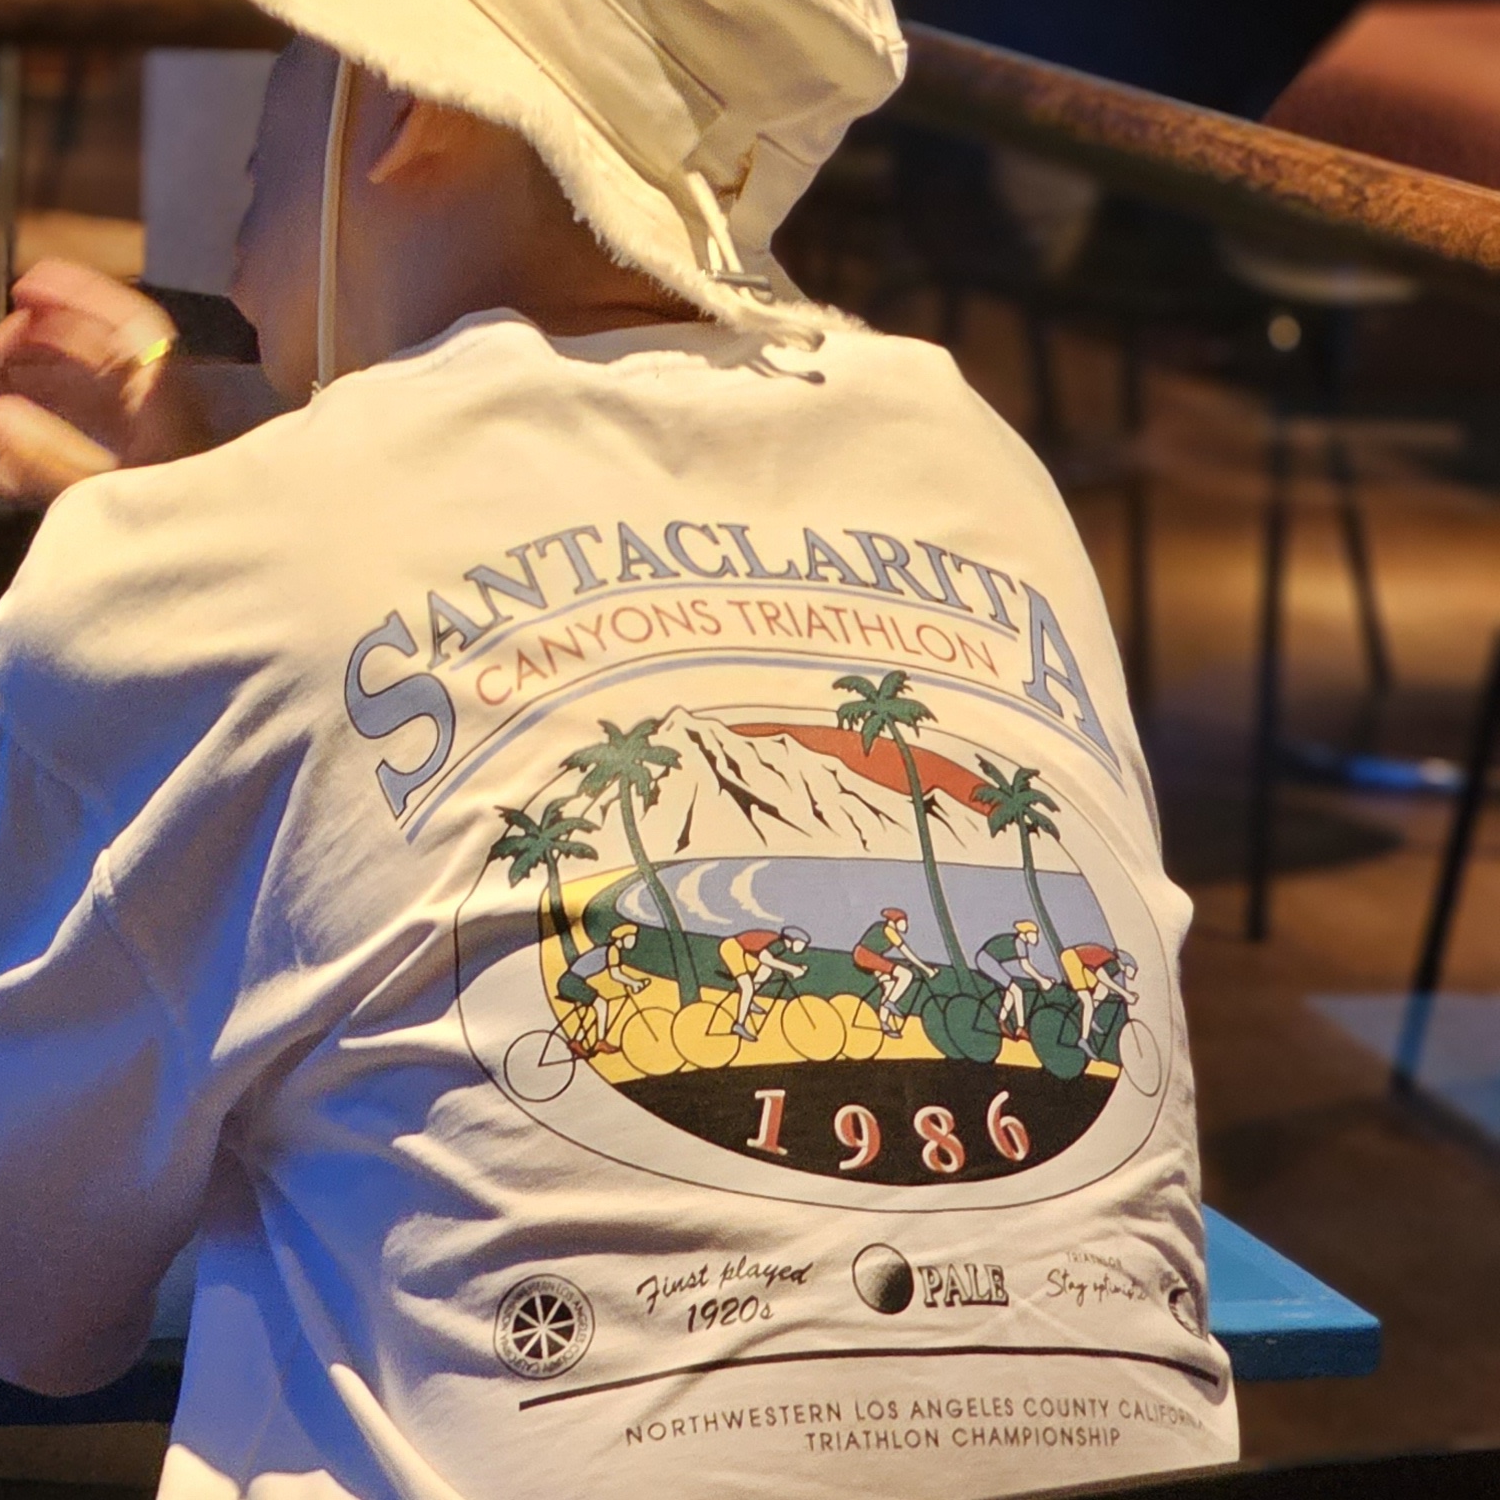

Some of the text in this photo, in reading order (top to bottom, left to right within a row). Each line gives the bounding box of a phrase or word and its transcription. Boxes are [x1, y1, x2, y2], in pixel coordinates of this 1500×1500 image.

[476, 599, 1000, 706] CANYONS TRIATHLON
[746, 1089, 1031, 1174] 1986
[636, 1254, 814, 1316] First played
[687, 1294, 774, 1333] 1920s
[625, 1402, 842, 1446] NORTHWESTERN
[854, 1400, 899, 1421] LOS
[910, 1398, 1014, 1419] ANGELES
[1023, 1397, 1109, 1417] COUNTY
[806, 1426, 1121, 1451] TRIATHLON CHAMPIONSHIP
